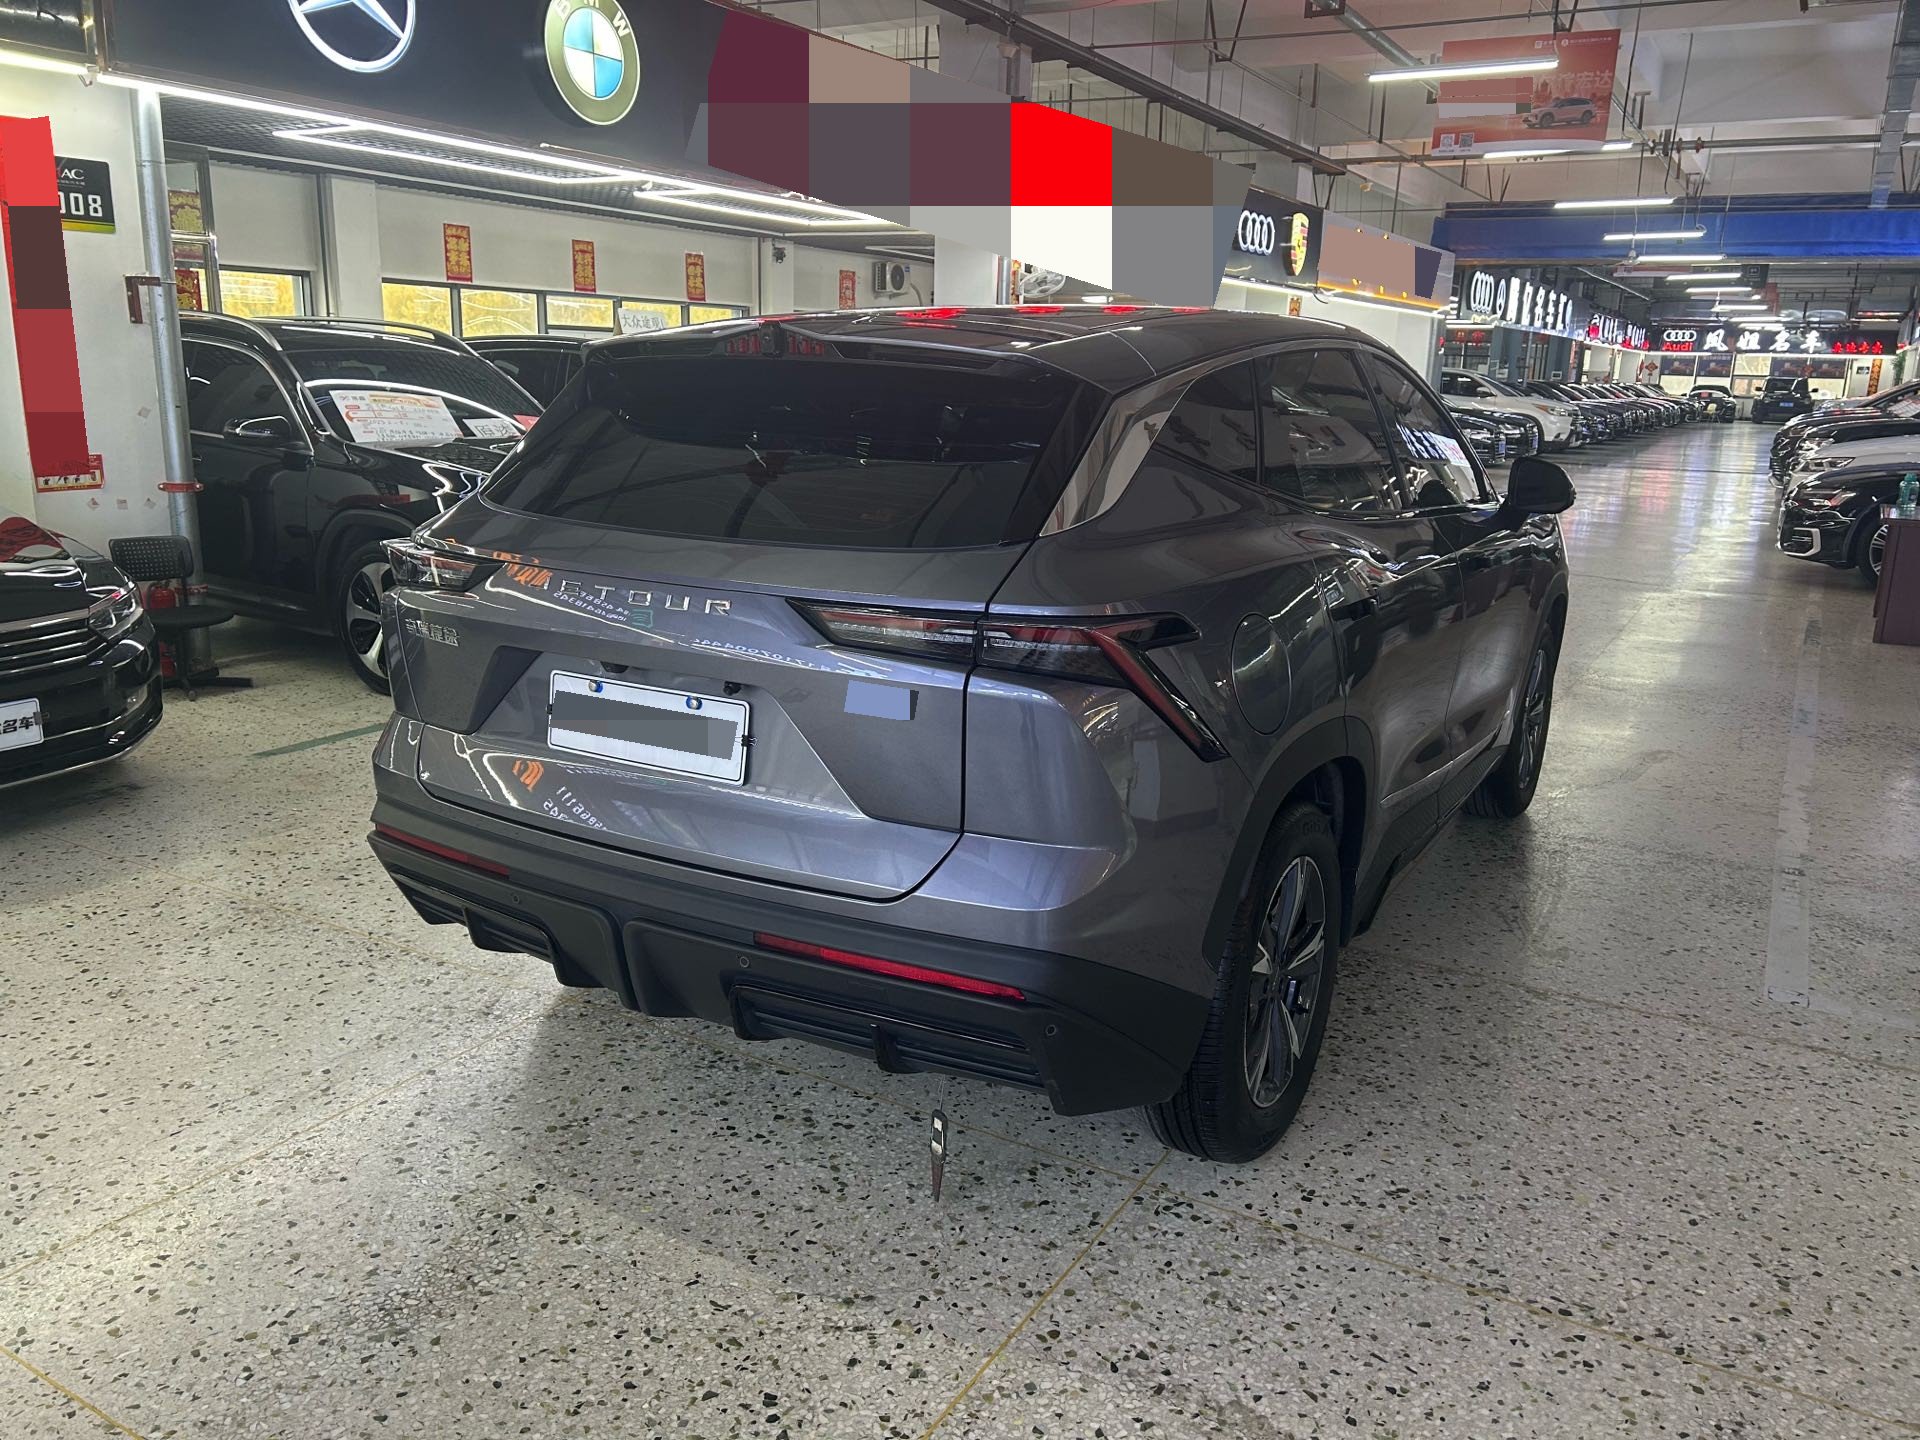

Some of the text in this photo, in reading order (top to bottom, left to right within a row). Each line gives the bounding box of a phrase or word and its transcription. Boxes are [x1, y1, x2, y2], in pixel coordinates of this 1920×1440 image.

[1662, 340, 1694, 351] Audi
[528, 575, 731, 617] JETOUR
[0, 716, 34, 735] 名车
